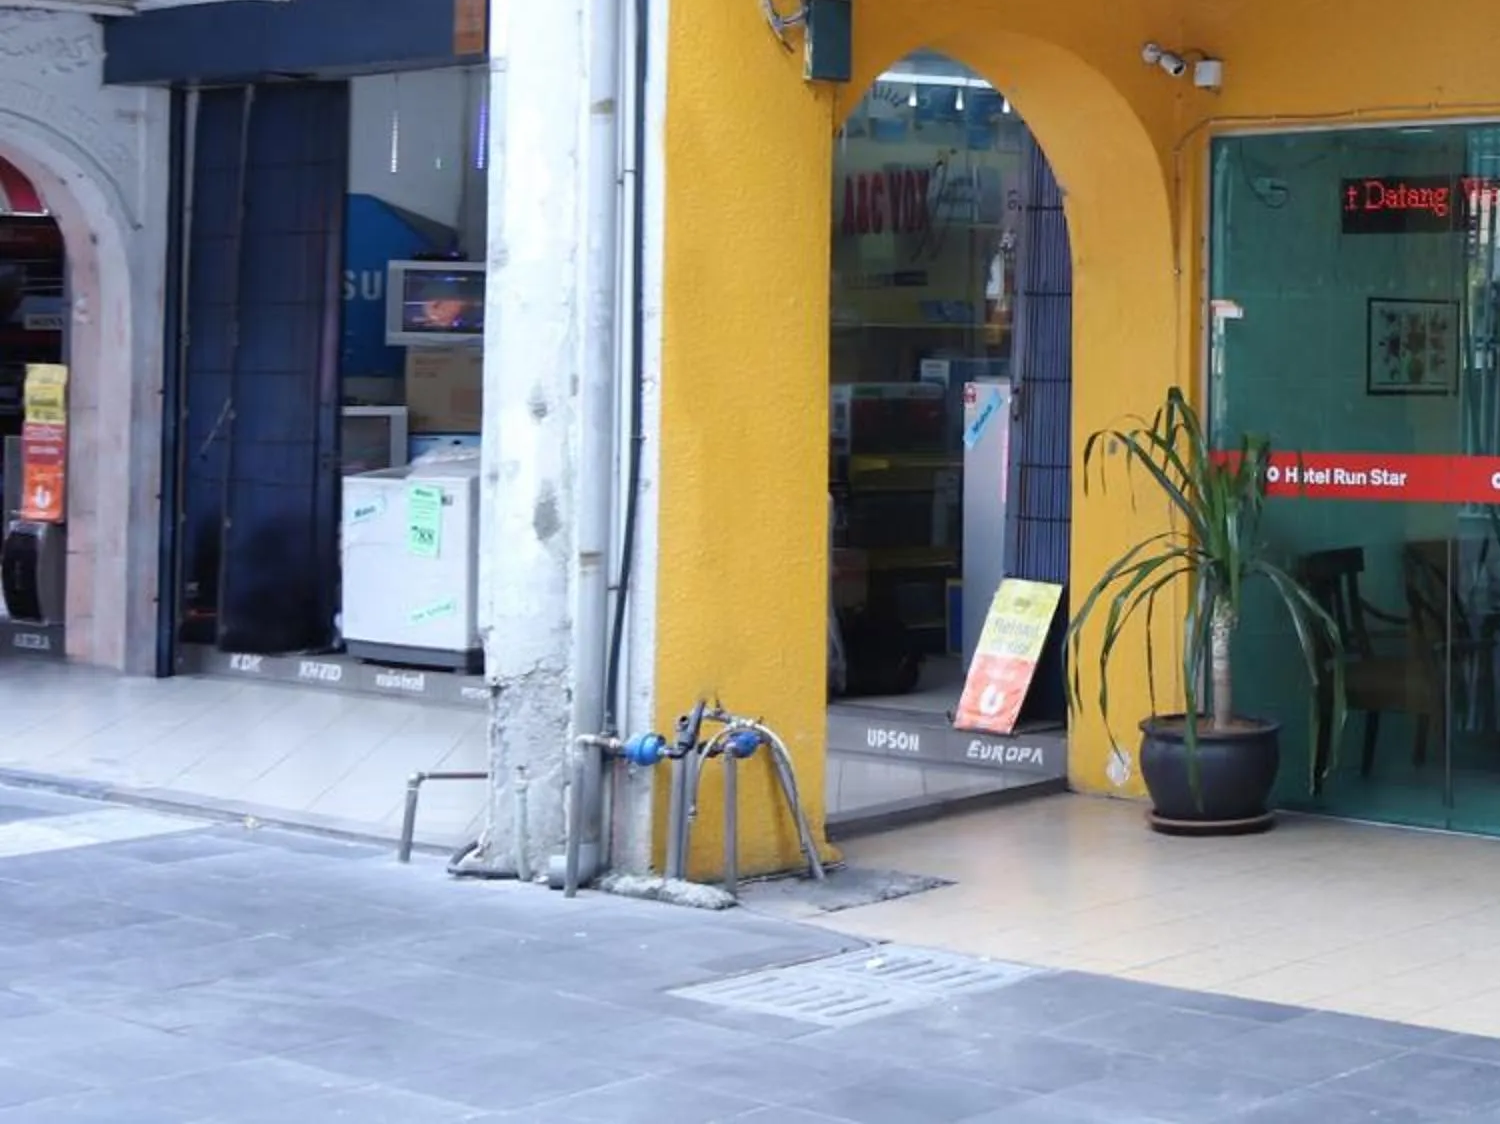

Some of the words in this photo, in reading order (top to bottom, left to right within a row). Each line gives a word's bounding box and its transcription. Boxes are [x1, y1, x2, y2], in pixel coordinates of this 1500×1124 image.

[1364, 180, 1449, 217] Datang
[1334, 468, 1367, 485] Run
[1370, 469, 1407, 487] Star
[966, 739, 1044, 765] EUROPA
